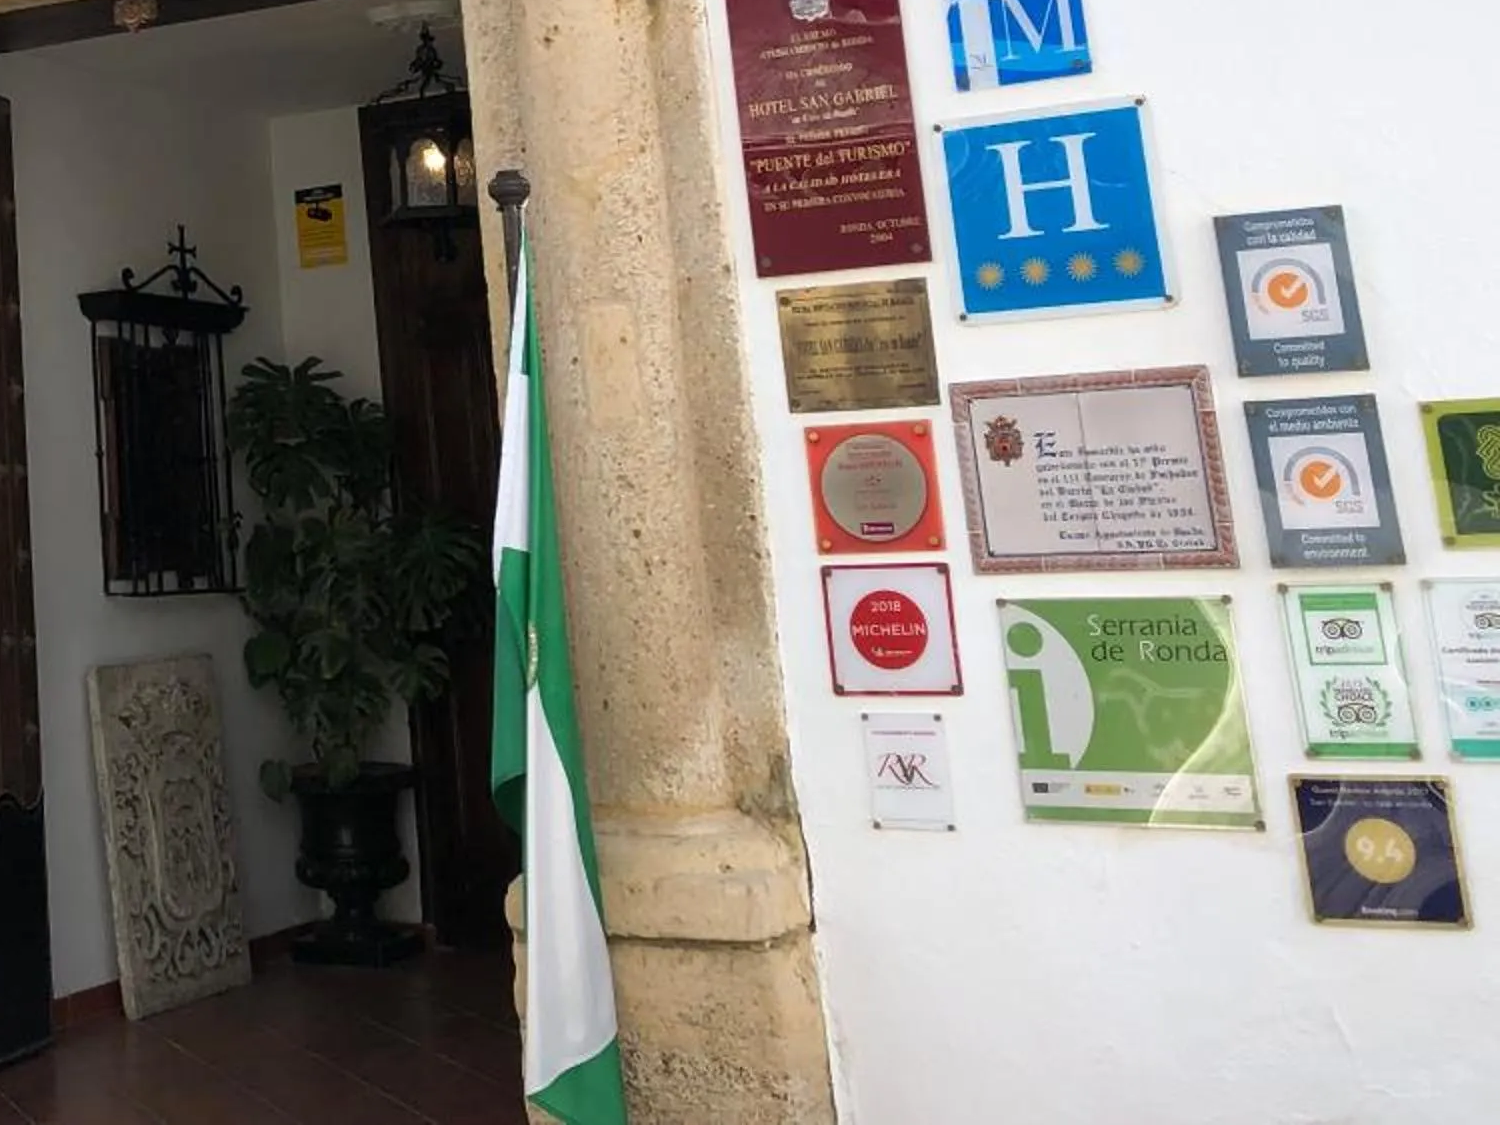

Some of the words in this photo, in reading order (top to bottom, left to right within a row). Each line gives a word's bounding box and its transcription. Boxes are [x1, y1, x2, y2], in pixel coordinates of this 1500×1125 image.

[749, 99, 797, 118] HOTEL
[800, 94, 829, 110] SAN
[833, 84, 898, 106] GABRIEL
[816, 151, 835, 166] del
[838, 140, 911, 163] TURISMO"
[985, 132, 1109, 239] H
[870, 600, 902, 613] 2018
[852, 622, 926, 637] MICHELIN
[1091, 639, 1125, 662] de
[1139, 640, 1229, 662] Ronda
[1355, 835, 1405, 863] 9.4
